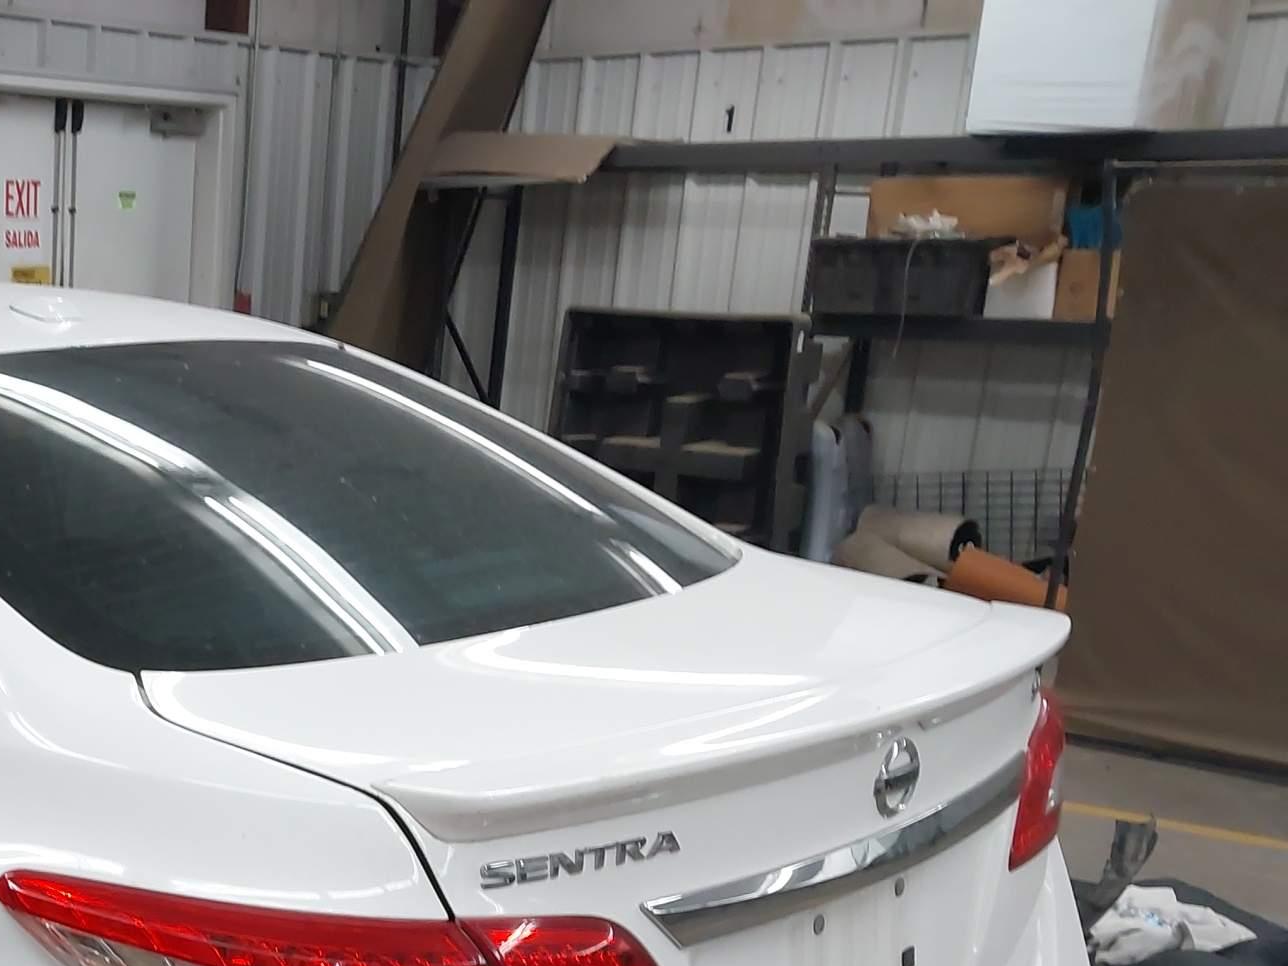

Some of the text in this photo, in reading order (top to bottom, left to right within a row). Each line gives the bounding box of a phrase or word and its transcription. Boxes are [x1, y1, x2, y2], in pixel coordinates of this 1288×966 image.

[725, 105, 735, 133] 1
[5, 179, 41, 218] EXIT
[4, 229, 40, 249] SALIDA
[479, 830, 681, 889] SENTRA
